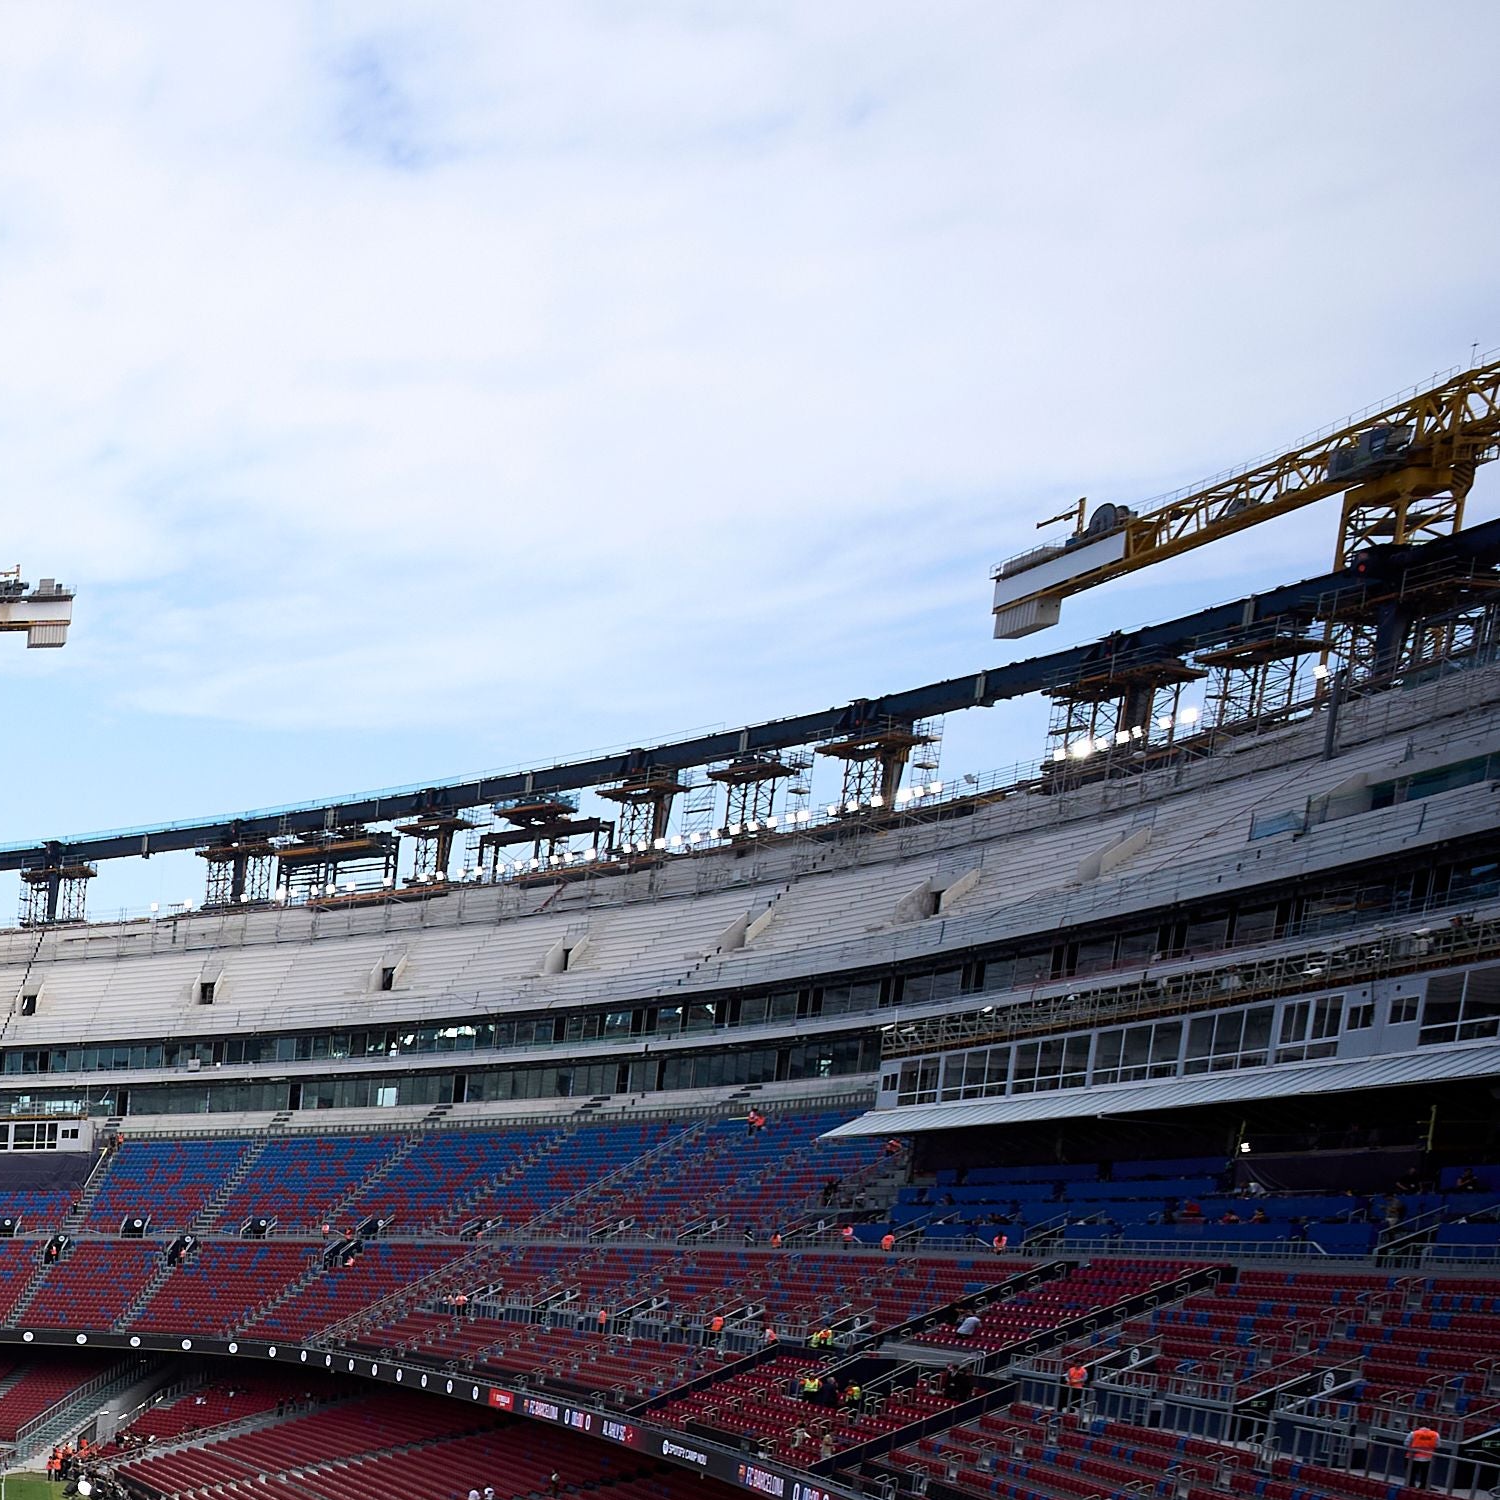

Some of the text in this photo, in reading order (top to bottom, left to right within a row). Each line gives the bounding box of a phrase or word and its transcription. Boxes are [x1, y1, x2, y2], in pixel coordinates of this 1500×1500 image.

[564, 1408, 570, 1425] 0
[585, 1414, 591, 1431] 0
[746, 1467, 754, 1485] FC
[753, 1470, 784, 1497] BARCELONA
